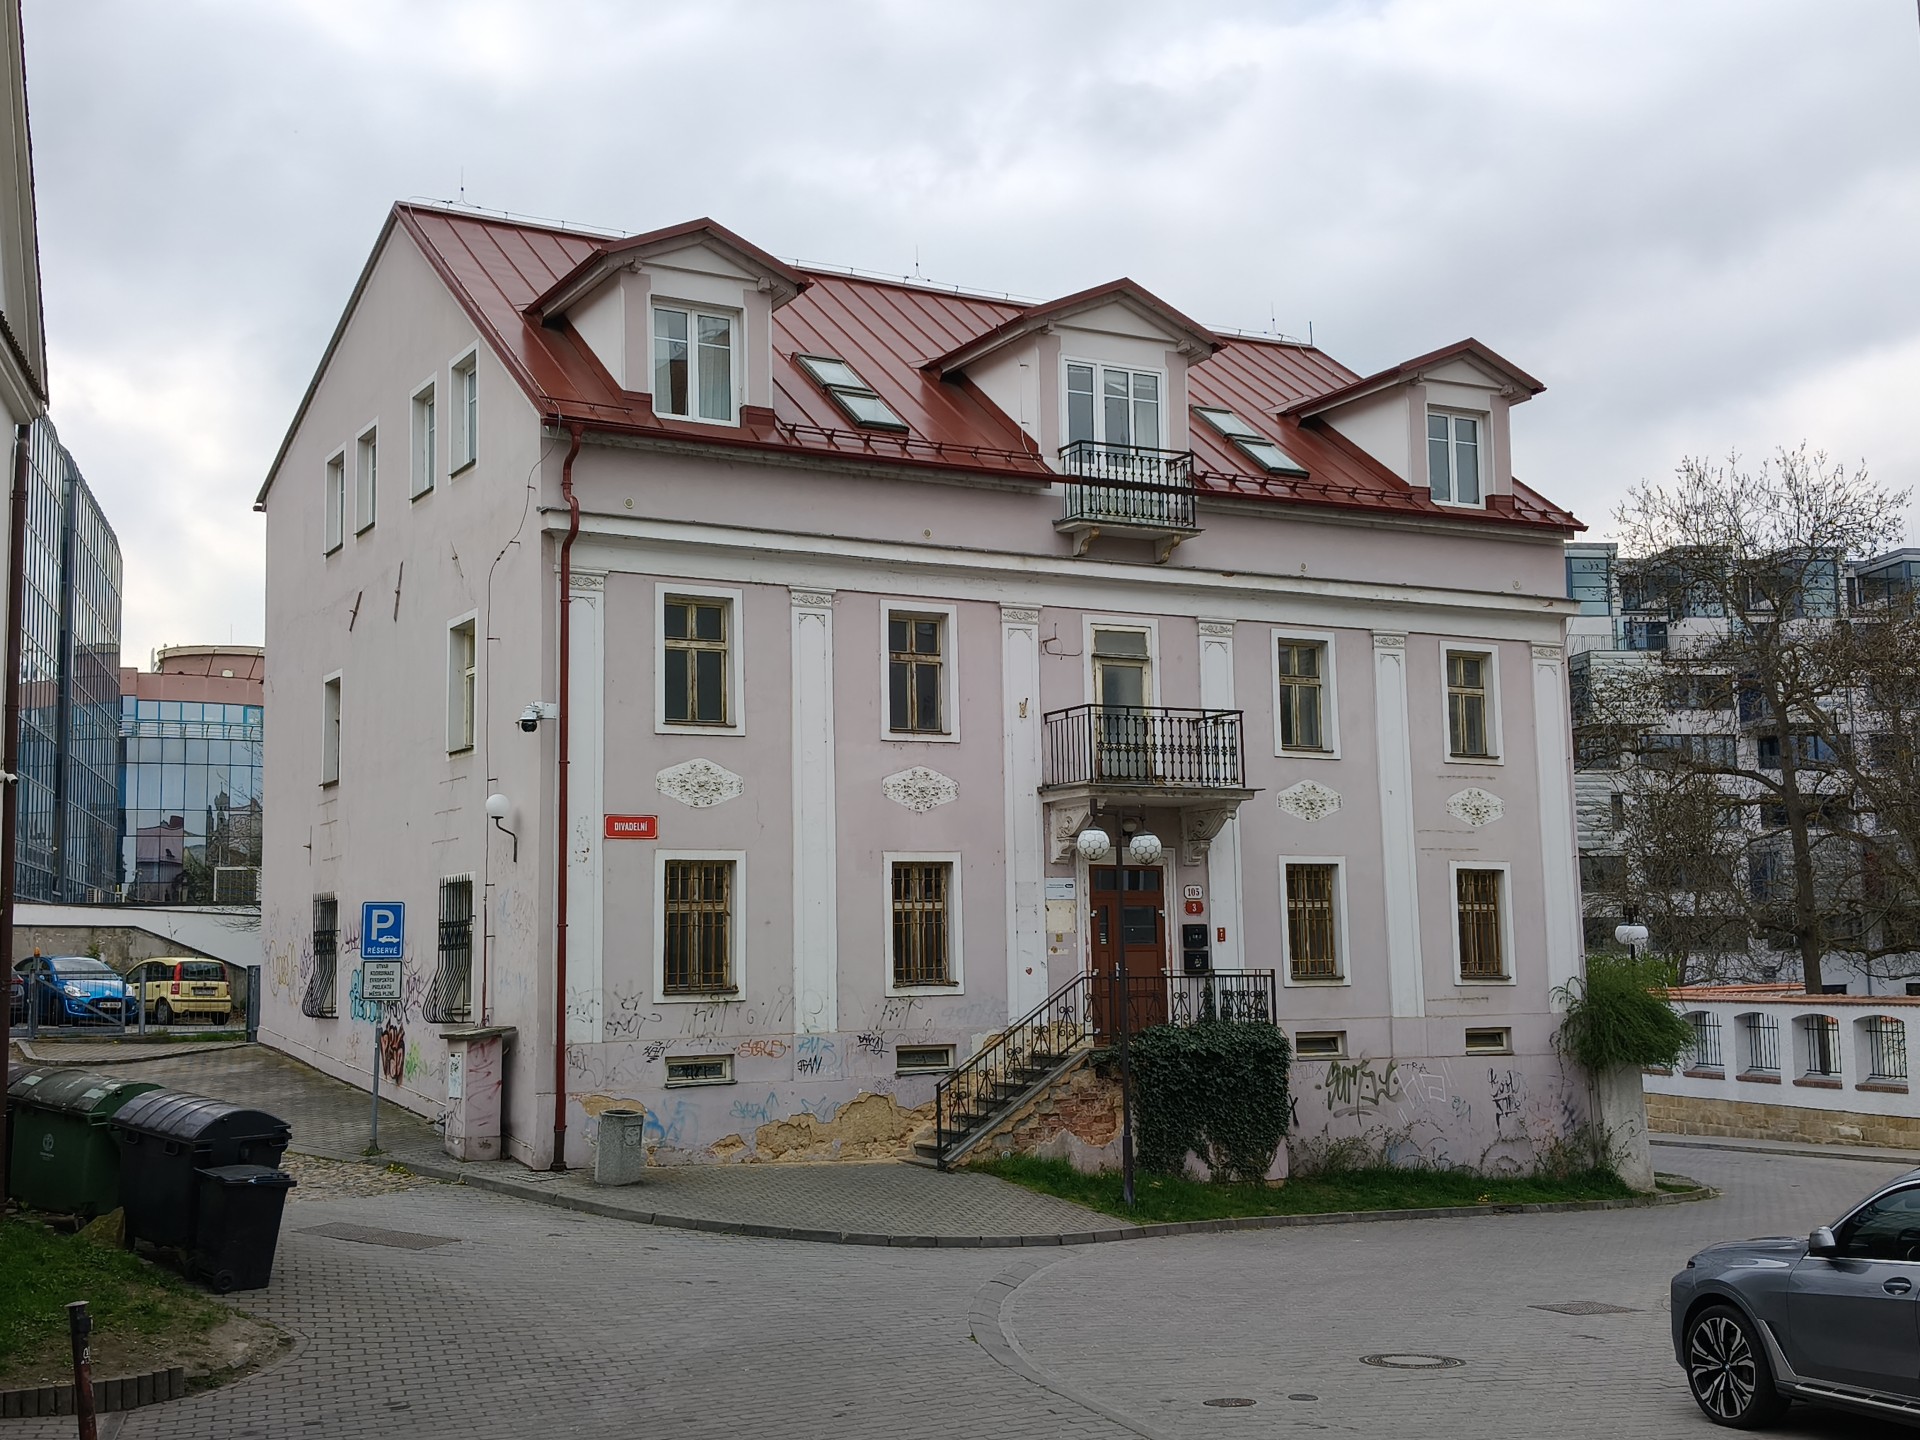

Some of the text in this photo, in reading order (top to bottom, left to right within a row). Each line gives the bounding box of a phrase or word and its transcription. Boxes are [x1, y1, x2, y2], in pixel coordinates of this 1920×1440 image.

[614, 821, 648, 831] DIVADELNÍ
[1188, 888, 1200, 897] 105
[1192, 903, 1197, 912] 3
[371, 909, 395, 940] P
[367, 946, 398, 954] RÉSERVÉ
